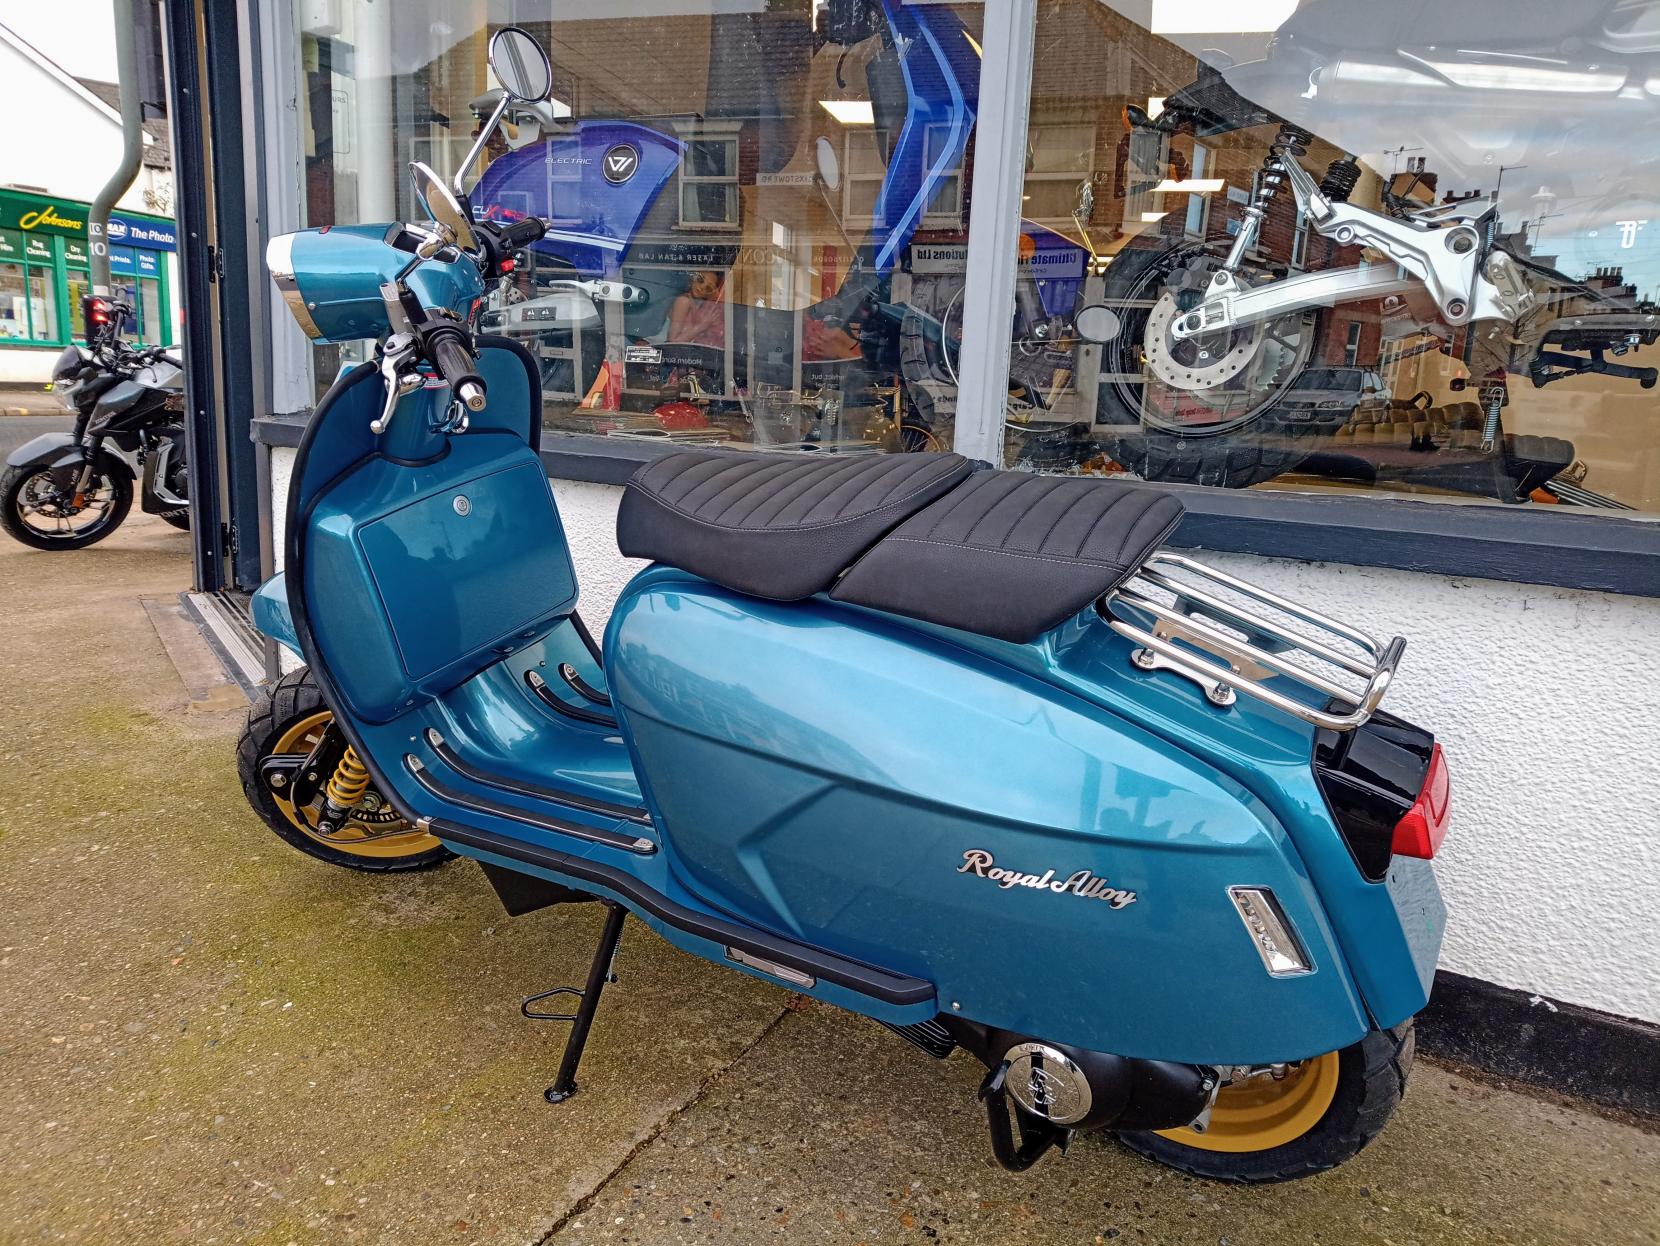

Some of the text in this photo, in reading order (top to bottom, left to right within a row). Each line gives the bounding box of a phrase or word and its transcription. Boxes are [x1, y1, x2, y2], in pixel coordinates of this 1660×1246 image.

[545, 157, 593, 165] ELECTRIC
[19, 206, 83, 230] Johnsons
[130, 227, 175, 243] The Photo
[26, 247, 51, 258] Cleaning
[70, 245, 81, 254] Dry
[89, 241, 106, 256] 10
[65, 252, 88, 262] Cleaning
[957, 848, 1138, 910] Royal Alloy
